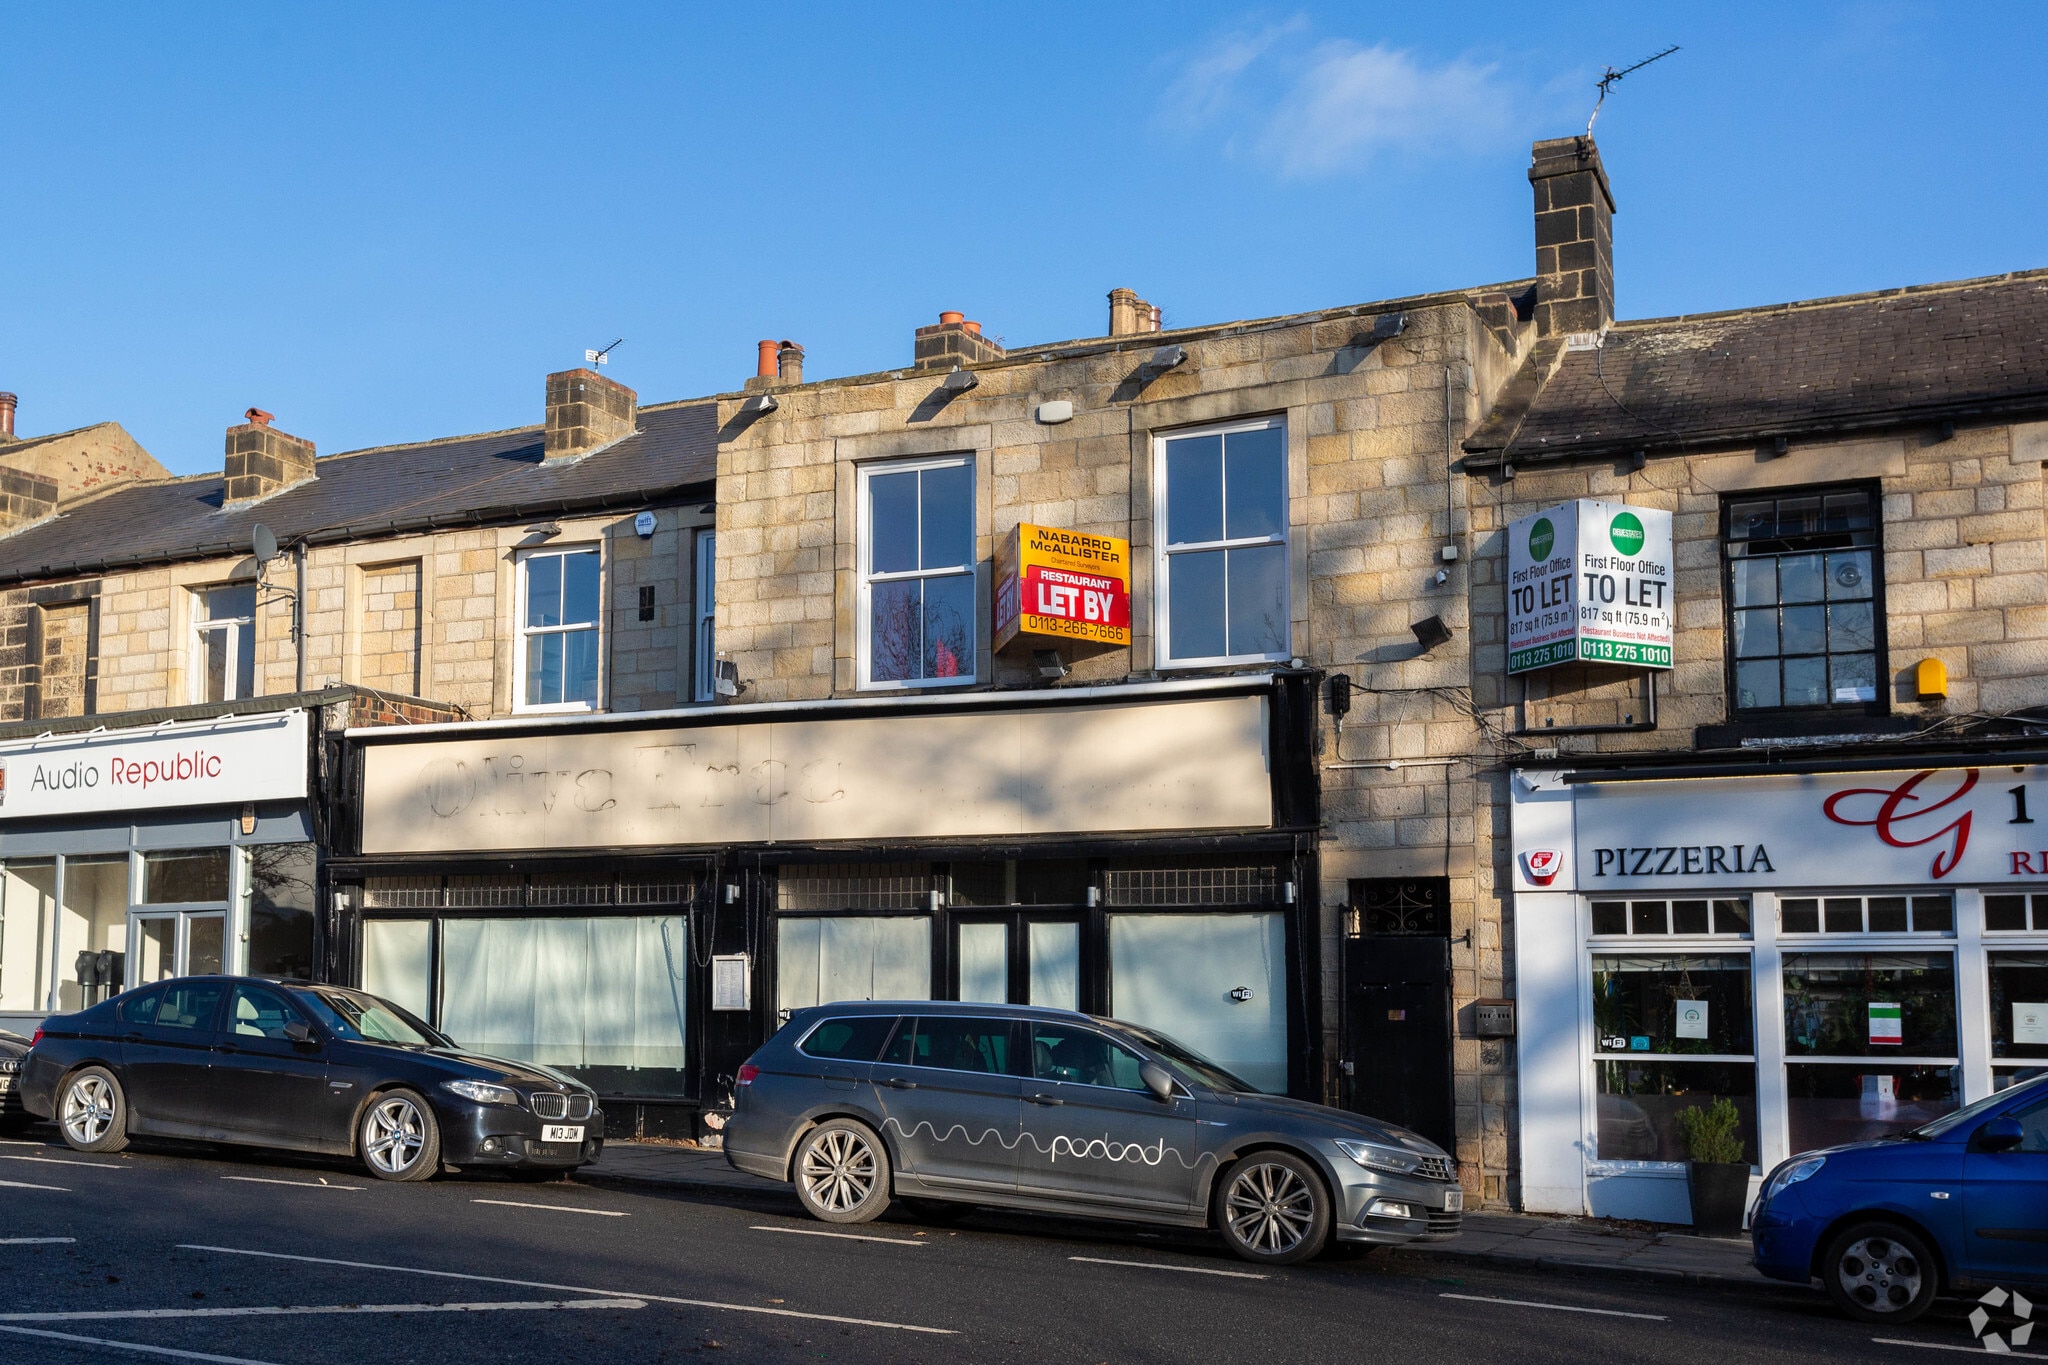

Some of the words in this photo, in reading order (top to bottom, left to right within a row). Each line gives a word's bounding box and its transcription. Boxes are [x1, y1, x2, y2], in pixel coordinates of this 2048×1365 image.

[1030, 540, 1120, 563] McALLISTER
[1038, 530, 1112, 551] NABARRO
[1512, 568, 1528, 584] First
[1529, 564, 1548, 579] Floor
[1549, 557, 1571, 574] Office
[1584, 554, 1607, 569] First
[1610, 557, 1635, 572] Floor
[1638, 560, 1666, 576] Office
[1040, 570, 1112, 590] RESTAURANT
[1583, 572, 1616, 604] TO
[1625, 577, 1667, 609] LET
[1037, 582, 1080, 618] LET
[1084, 589, 1114, 622] BY
[1511, 584, 1535, 616] TO
[1540, 572, 1573, 610] LET
[1028, 615, 1124, 640] 0113-266-7666
[1510, 620, 1523, 635] 817
[1524, 621, 1533, 633] sq
[1534, 616, 1540, 629] ft
[1541, 611, 1559, 630] (75.9
[1580, 606, 1599, 620] 817
[1601, 611, 1613, 625] sq
[1615, 610, 1622, 623] ft
[1625, 611, 1649, 626] (75.9
[1612, 629, 1636, 640] Business
[1636, 632, 1647, 641] Not
[1510, 651, 1532, 669] 0113
[1533, 647, 1550, 664] 275
[1552, 641, 1574, 659] 1010
[1583, 641, 1613, 658] 0113
[1615, 644, 1637, 660] 275
[1640, 646, 1669, 663] 1010
[31, 761, 99, 792] Audio
[111, 750, 222, 789] Republic
[1593, 843, 1777, 877] PIZZERIA
